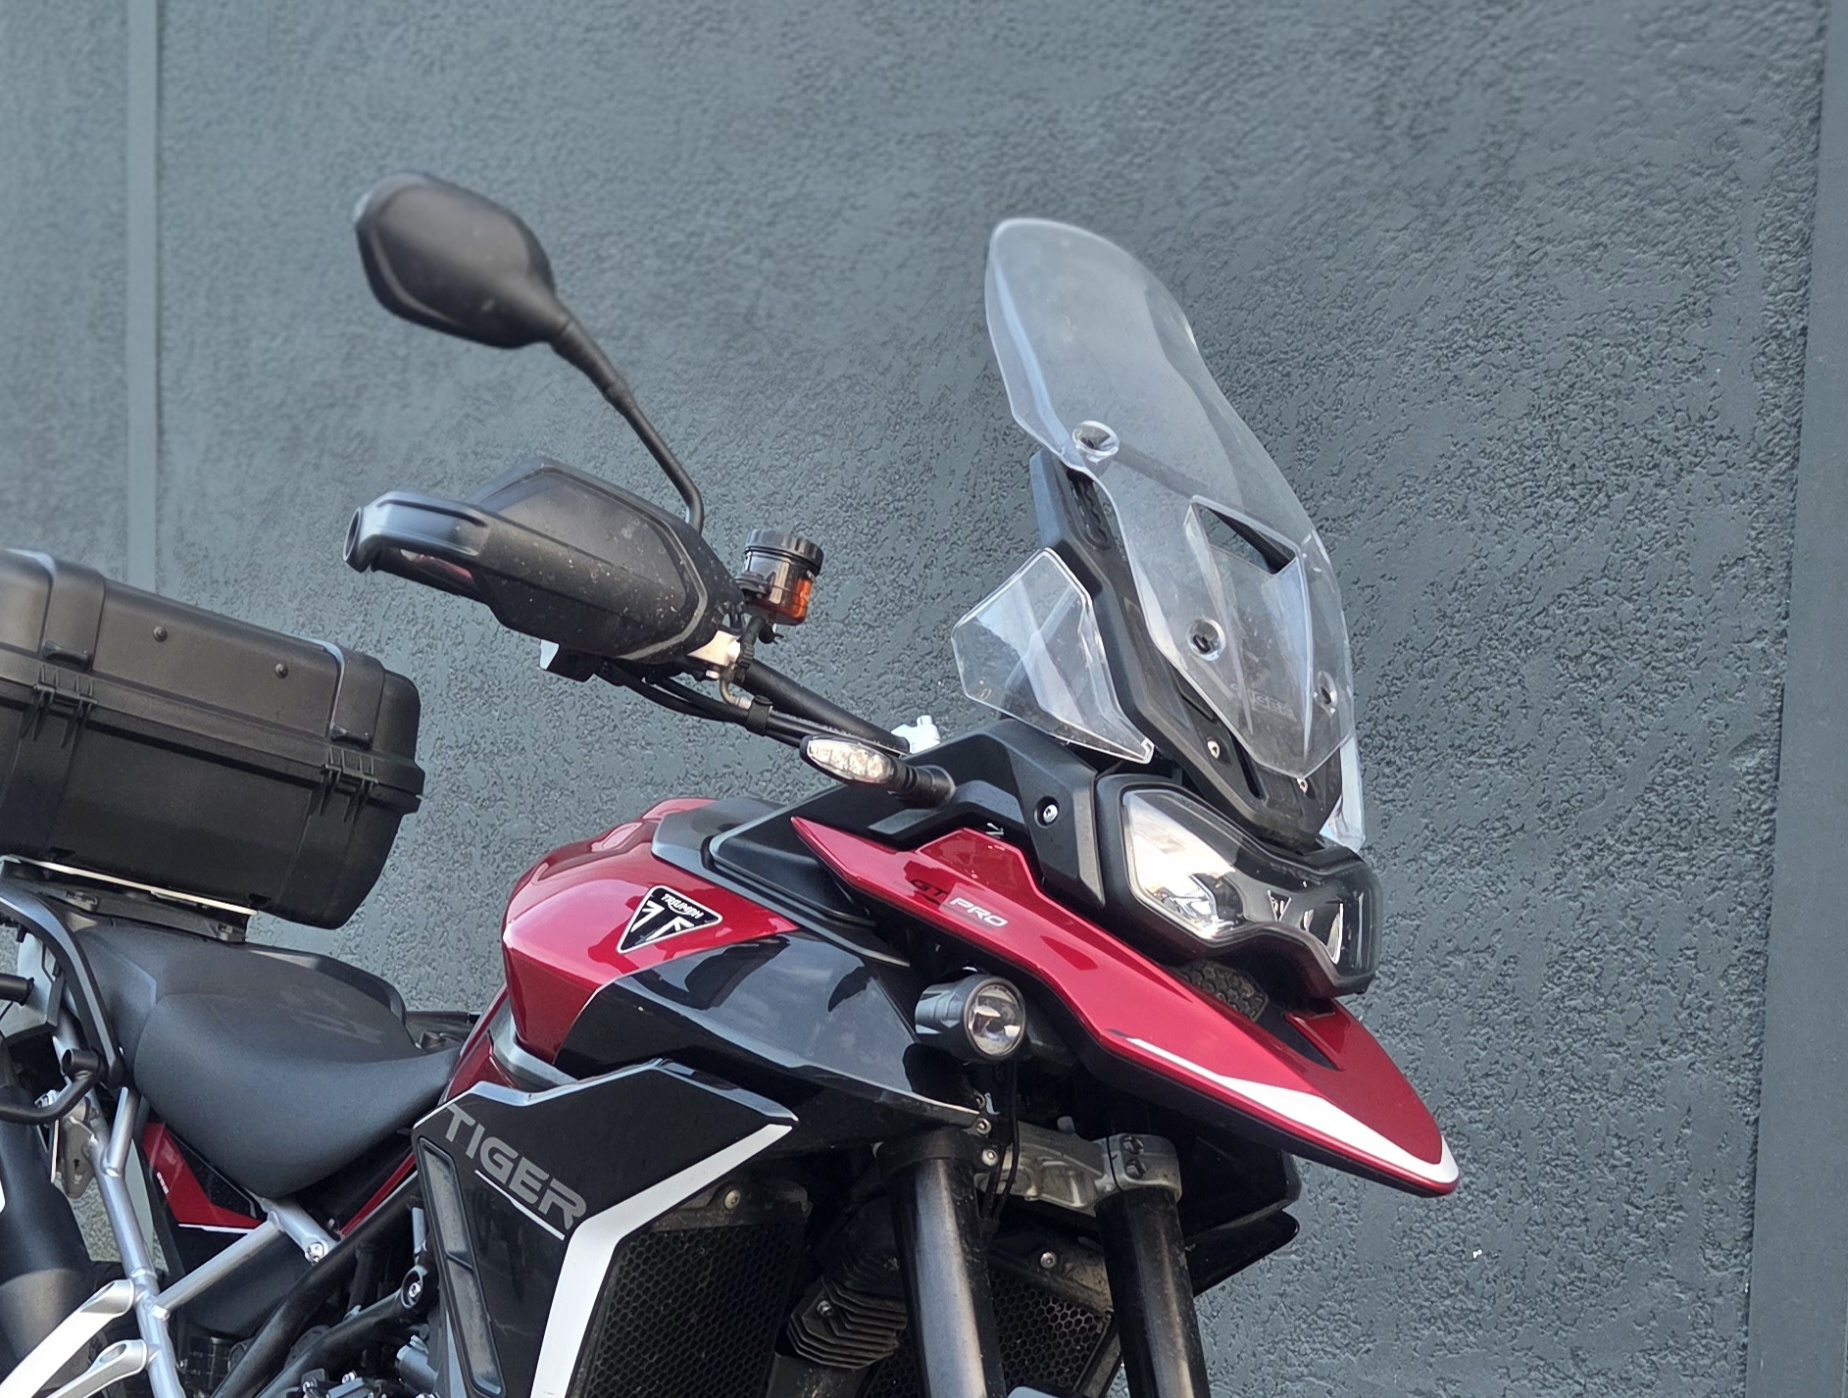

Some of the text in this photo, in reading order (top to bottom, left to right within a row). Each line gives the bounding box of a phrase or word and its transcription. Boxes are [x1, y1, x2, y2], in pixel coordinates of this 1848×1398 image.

[661, 893, 704, 919] TRIUMPH
[950, 897, 1008, 927] PRO
[445, 1103, 587, 1231] TIGER
